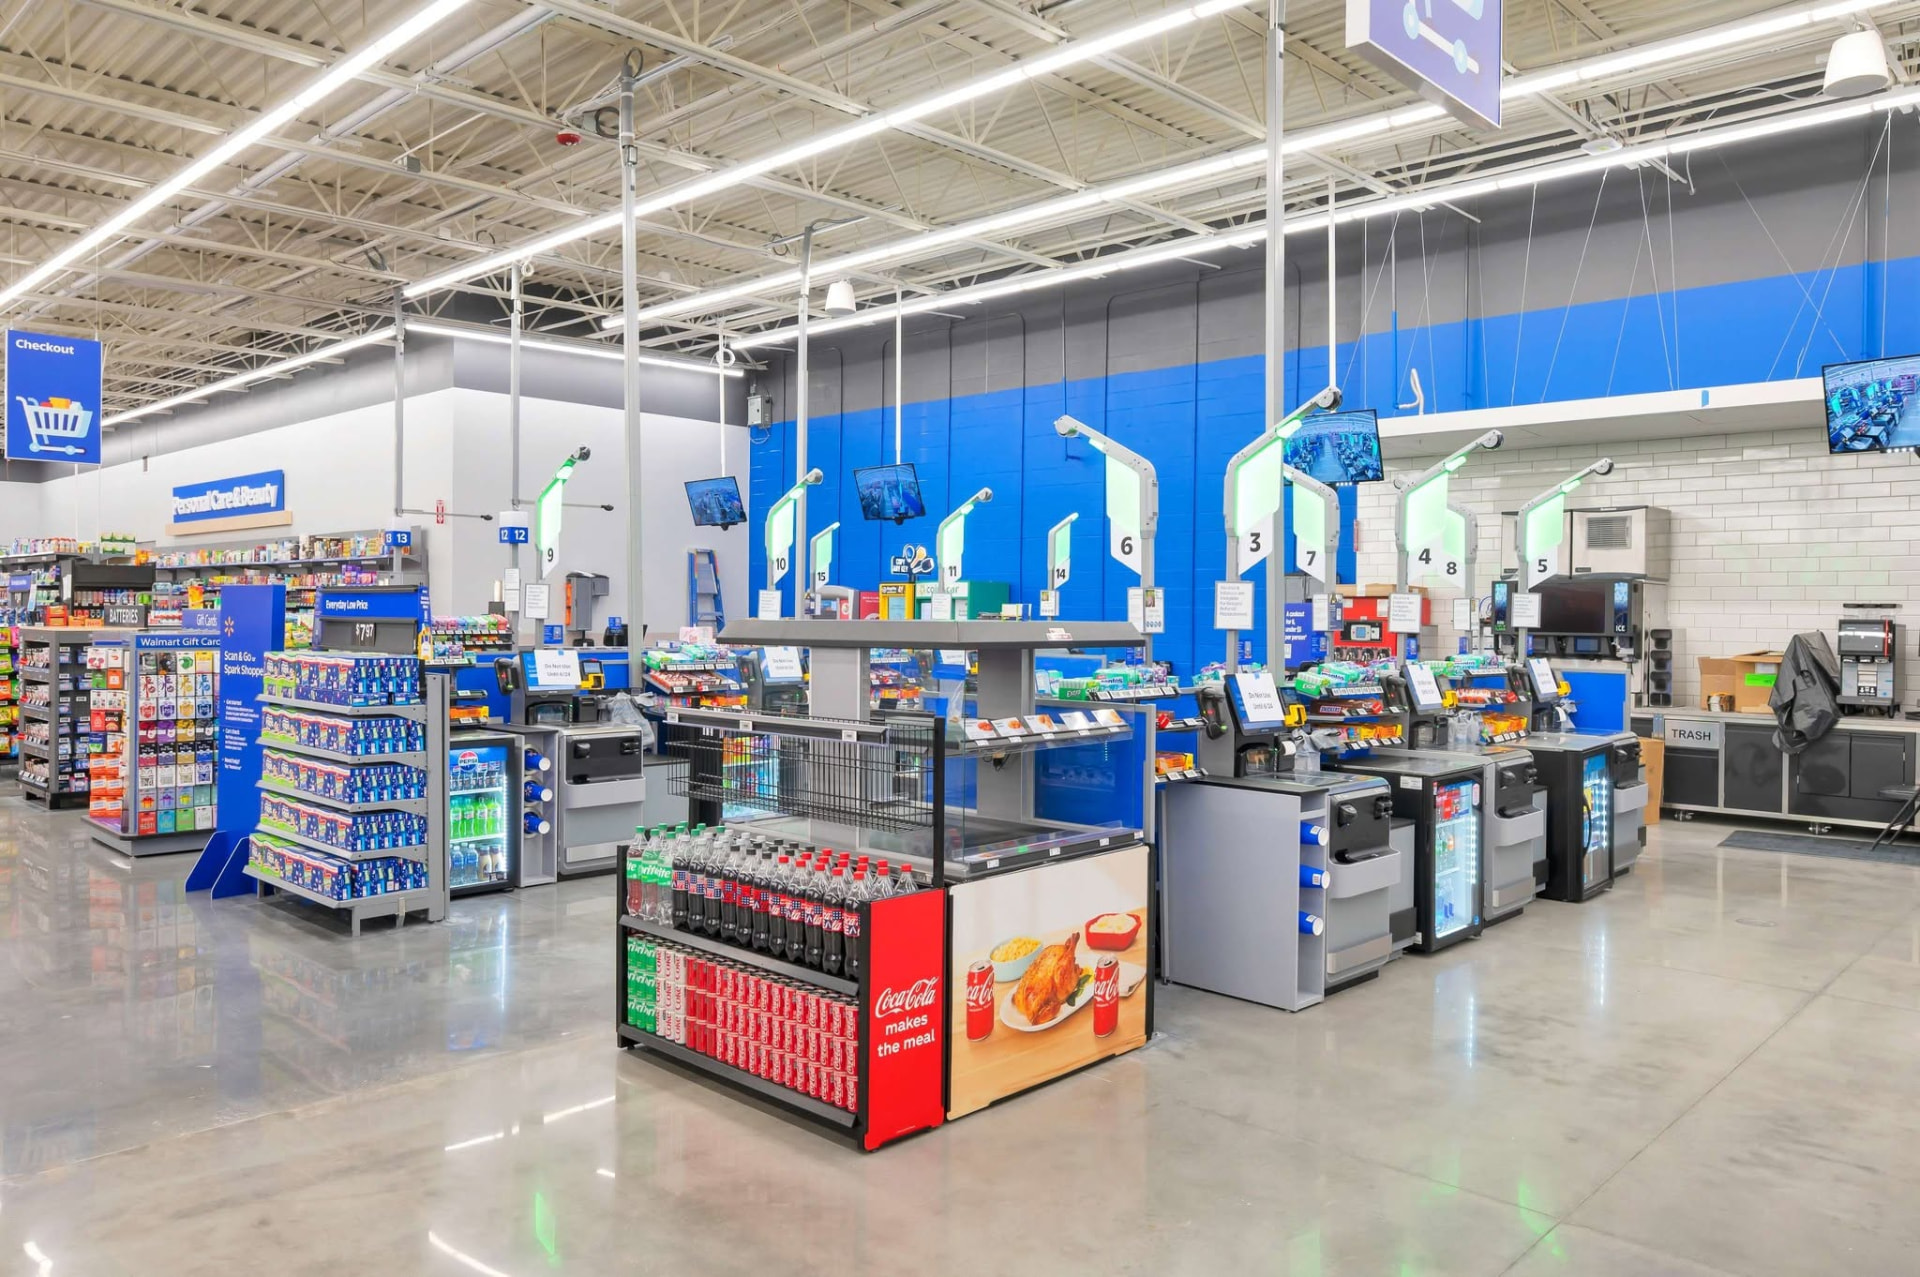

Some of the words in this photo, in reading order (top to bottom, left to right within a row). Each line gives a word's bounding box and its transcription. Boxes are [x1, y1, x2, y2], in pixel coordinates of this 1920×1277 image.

[15, 339, 75, 355] Checkout
[241, 483, 278, 507] Beauty
[397, 533, 408, 544] 13
[501, 529, 508, 540] 12
[514, 529, 526, 541] 12
[1120, 536, 1133, 555] 6
[1250, 533, 1261, 552] 3
[547, 548, 554, 563] 9
[1306, 550, 1316, 566] 7
[1418, 548, 1432, 565] 4
[775, 557, 786, 570] 10
[1446, 561, 1457, 575] 8
[1537, 559, 1548, 573] 5
[817, 572, 826, 582] 15
[949, 565, 957, 577] 11
[1055, 567, 1066, 580] 14
[325, 600, 347, 611] Everyday
[347, 600, 356, 609] Low
[357, 600, 368, 609] Price
[109, 608, 138, 623] BATTERIES
[197, 613, 205, 626] Gift
[141, 637, 180, 646] Walmart
[182, 637, 200, 646] Gift
[224, 650, 237, 661] Scan
[239, 651, 243, 662] &
[243, 651, 252, 662] Go
[224, 664, 240, 675] Spark
[1671, 728, 1711, 741] TRASH
[875, 976, 939, 1018] Coca-Cola
[885, 1014, 928, 1036] makes
[877, 1042, 900, 1057] the
[903, 1028, 935, 1050] meal
